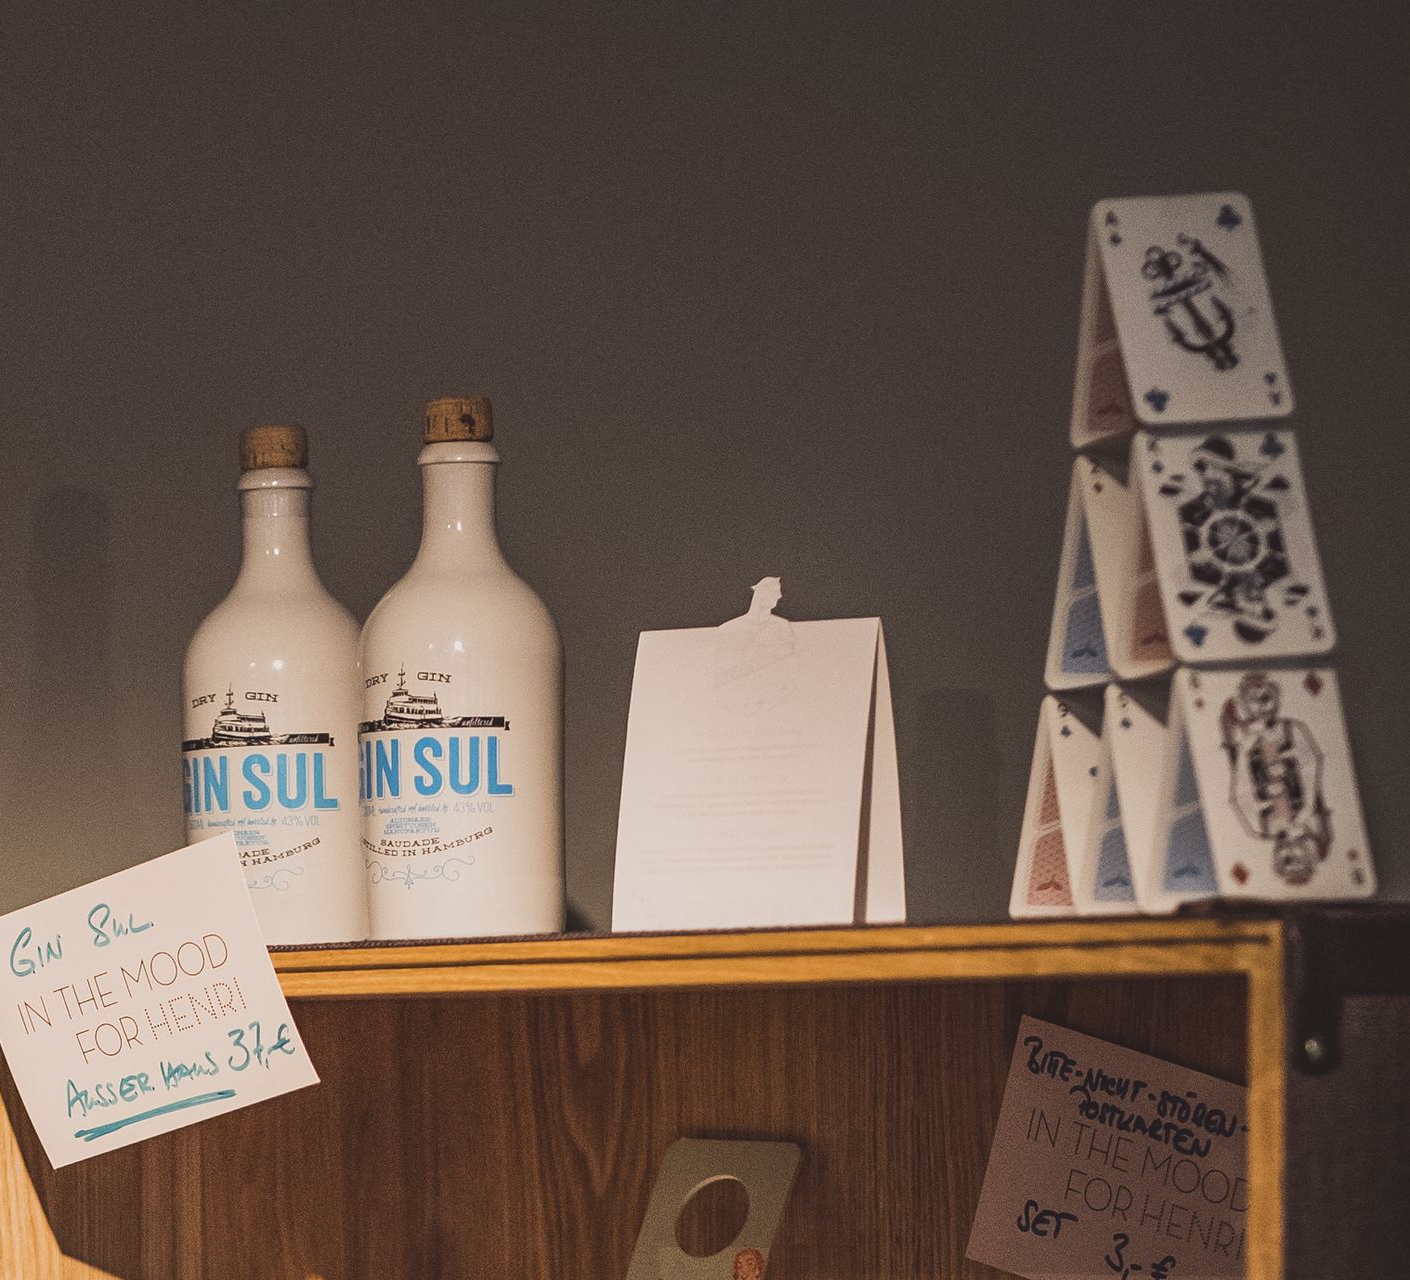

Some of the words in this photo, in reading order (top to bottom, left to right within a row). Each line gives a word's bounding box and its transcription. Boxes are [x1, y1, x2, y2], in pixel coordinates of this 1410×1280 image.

[192, 694, 216, 708] DRY
[245, 691, 279, 703] GIN
[365, 673, 389, 688] DRY
[417, 672, 452, 684] GIN
[241, 752, 340, 811] SUL
[413, 736, 514, 797] SUL
[252, 837, 321, 866] HAMBURG
[380, 837, 441, 848] SAUDADE
[421, 826, 494, 856] HAMBURG
[17, 997, 52, 1035] IN
[53, 972, 118, 1020] THE
[120, 934, 228, 999] MOOD
[75, 1016, 143, 1064] FOR
[144, 977, 247, 1040] HENRI
[1026, 1108, 1061, 1148] IN
[1071, 1120, 1134, 1173] THE
[1017, 1200, 1079, 1239] SET
[1065, 1169, 1133, 1221] FOR
[1140, 1194, 1245, 1261] HENRI
